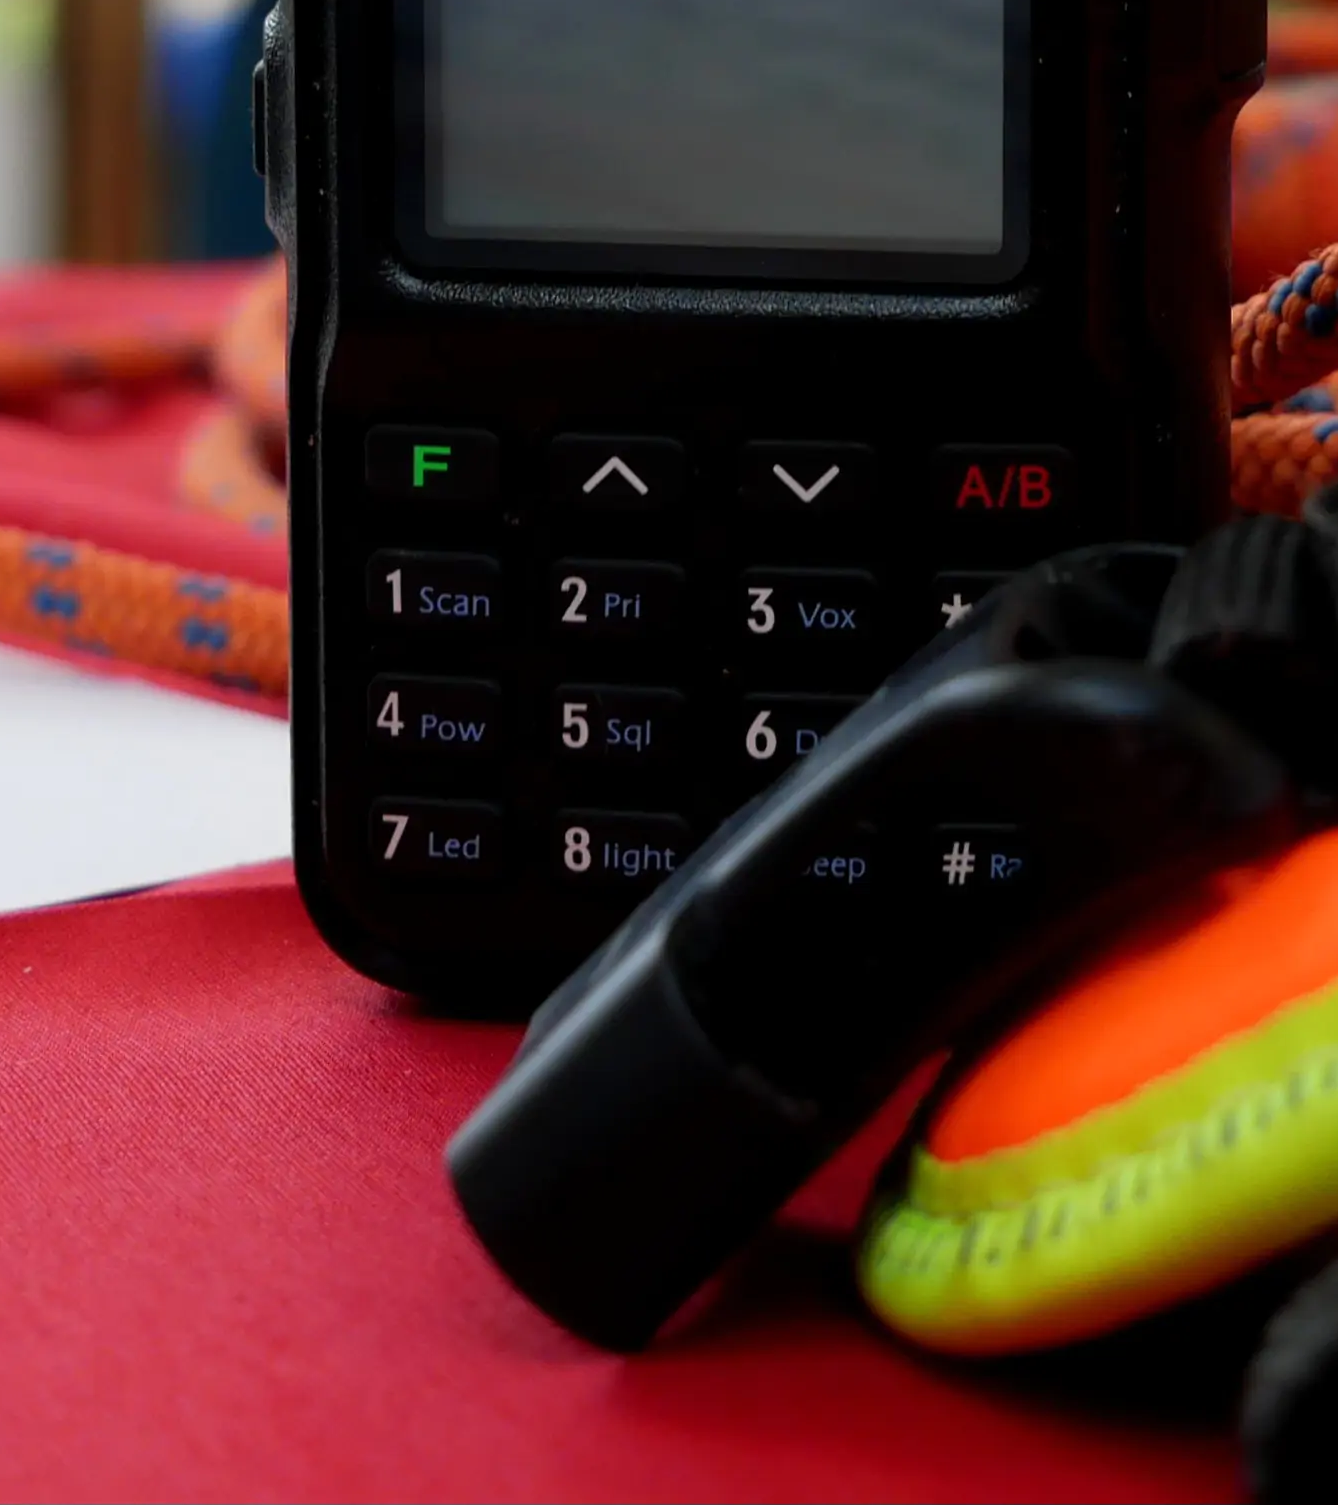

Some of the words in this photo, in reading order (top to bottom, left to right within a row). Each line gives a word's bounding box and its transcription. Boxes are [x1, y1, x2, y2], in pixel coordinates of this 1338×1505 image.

[413, 445, 451, 487] F
[955, 465, 1053, 509] A/B
[385, 569, 403, 614] 1
[419, 586, 491, 617] Scan
[561, 576, 588, 623] 2
[604, 593, 641, 619] Pri
[747, 588, 775, 634] 3
[798, 602, 857, 629] Vox
[376, 691, 404, 737] 4
[420, 715, 486, 742] Pow
[562, 703, 589, 749] 5
[606, 719, 651, 752] Sql
[745, 711, 777, 760] 6
[382, 814, 409, 860] 7
[428, 832, 480, 860] Led
[564, 827, 591, 872] 8
[604, 843, 675, 876] light
[802, 856, 867, 884] eep
[942, 842, 976, 885] #
